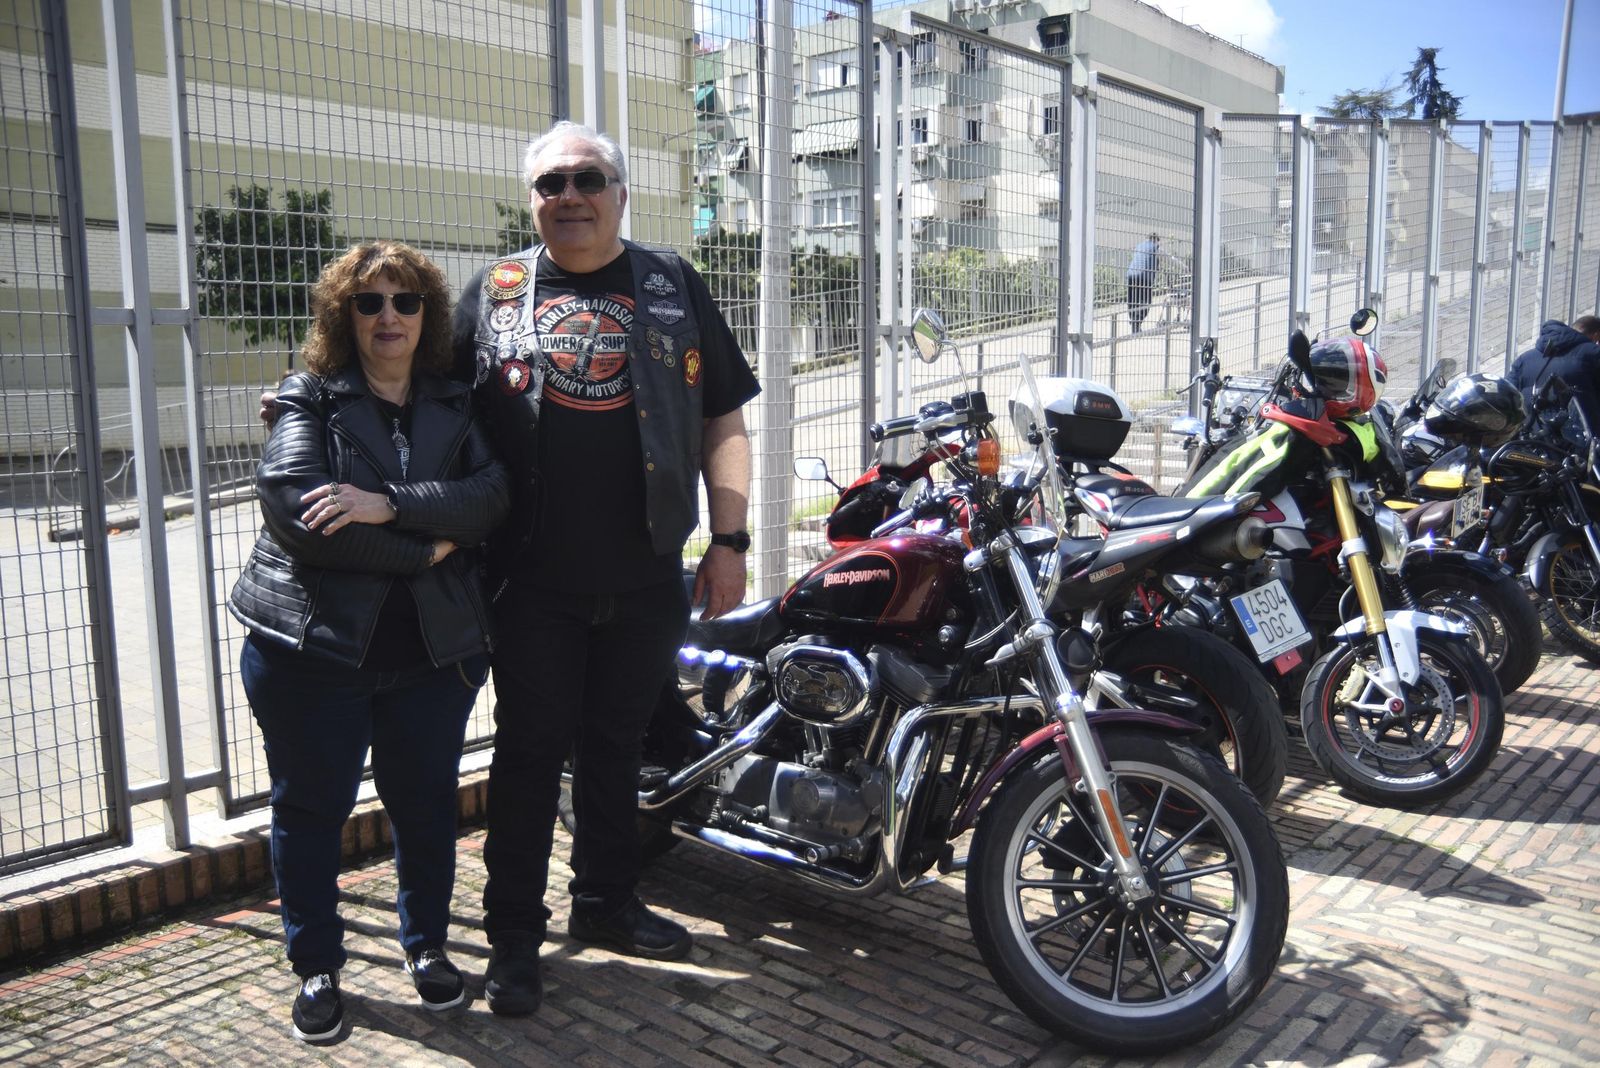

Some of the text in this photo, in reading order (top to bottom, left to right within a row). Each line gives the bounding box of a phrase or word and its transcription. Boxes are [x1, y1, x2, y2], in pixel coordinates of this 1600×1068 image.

[1091, 400, 1111, 409] BMW
[823, 569, 890, 587] HARLEY-DAVIDSON
[1247, 586, 1288, 617] 4504
[1258, 612, 1293, 643] DGC
